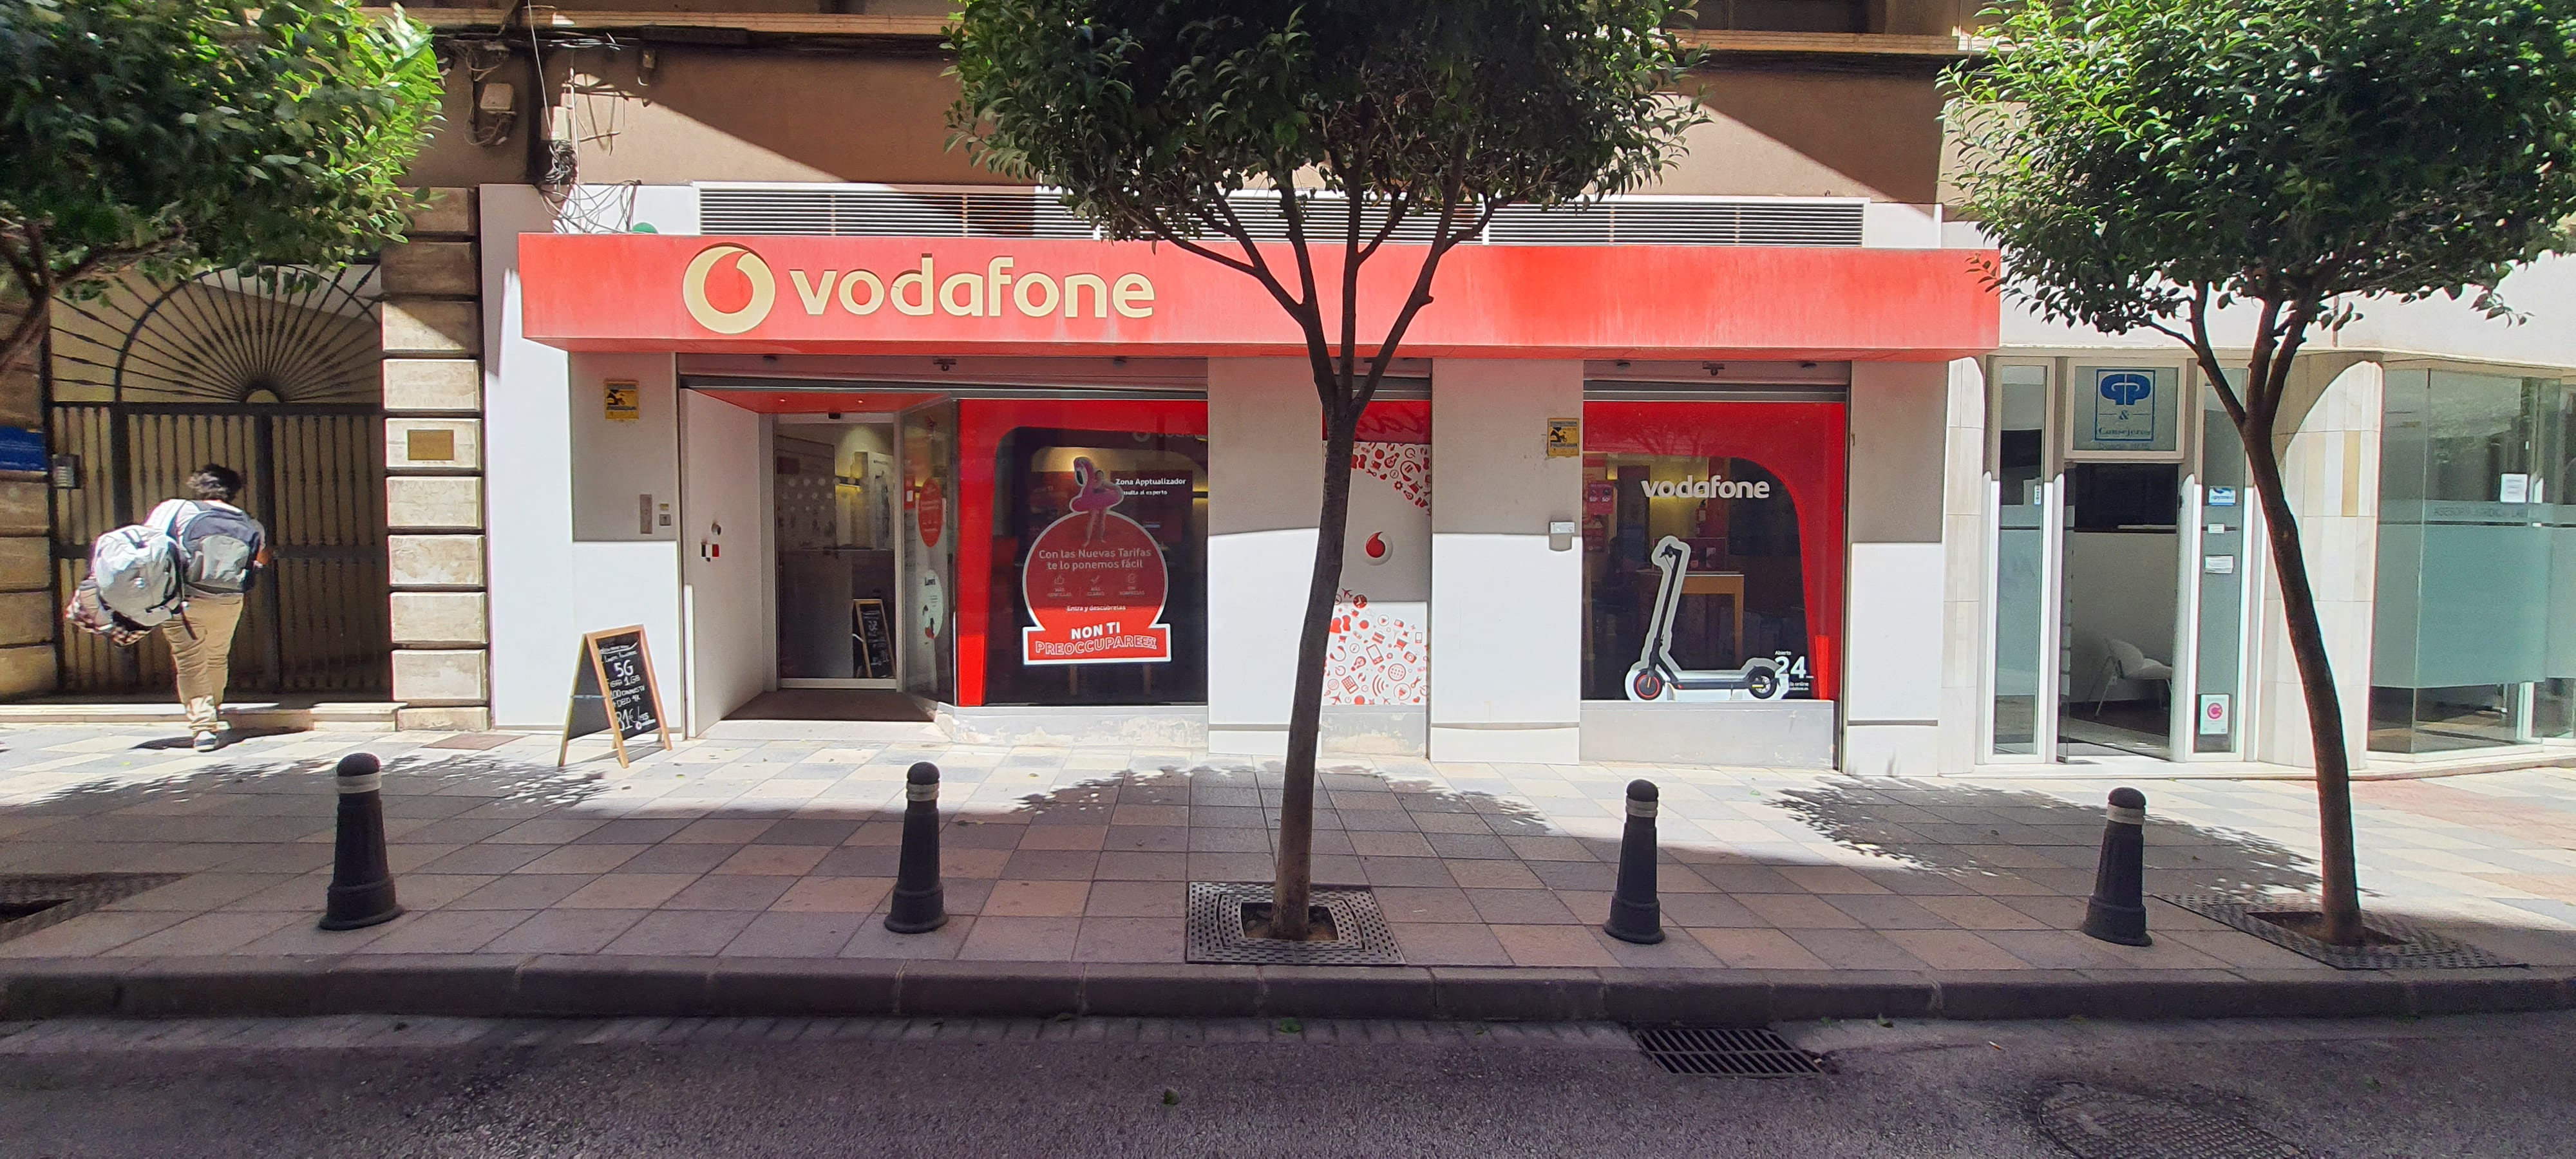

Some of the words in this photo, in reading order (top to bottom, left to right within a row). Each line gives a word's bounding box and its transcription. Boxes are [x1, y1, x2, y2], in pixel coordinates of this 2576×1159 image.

[789, 253, 1155, 317] vodafone
[1135, 478, 1186, 487] Apptualizador
[1640, 475, 1770, 498] vodafone
[1039, 550, 1058, 559] Con
[1061, 549, 1075, 558] las
[1078, 549, 1115, 558] Nuevas
[1117, 548, 1151, 557] Tarifas
[1047, 561, 1057, 570] te
[1060, 561, 1070, 569] lo
[1072, 560, 1119, 571] ponemos
[1121, 559, 1143, 568] fácil
[1071, 624, 1103, 639] NON
[1106, 621, 1121, 635] TI
[614, 659, 634, 677] 5G
